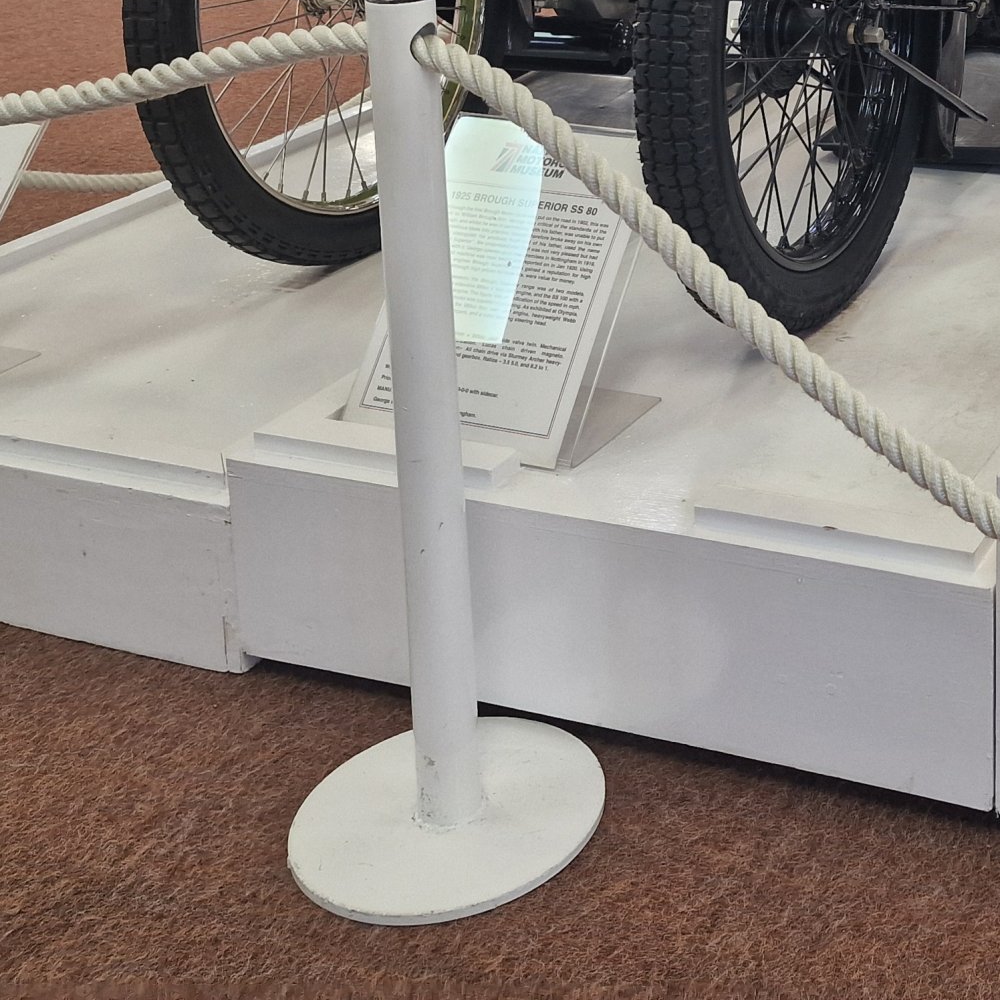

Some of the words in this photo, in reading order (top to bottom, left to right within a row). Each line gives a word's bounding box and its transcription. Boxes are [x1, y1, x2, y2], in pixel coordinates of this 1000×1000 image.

[450, 190, 472, 201] 1925
[472, 193, 516, 206] BROUGH
[569, 204, 584, 214] SS
[585, 206, 598, 215] 80
